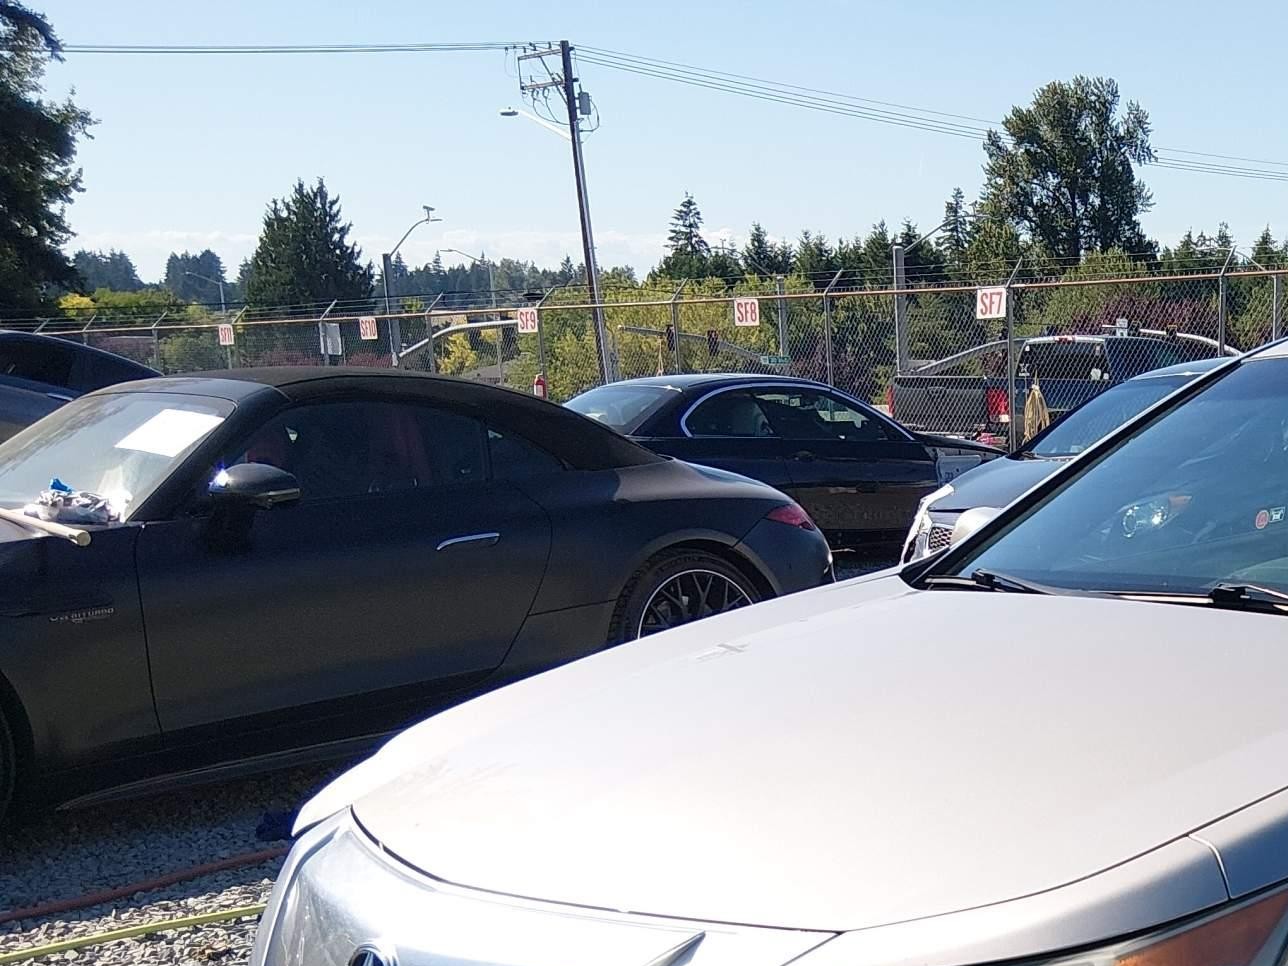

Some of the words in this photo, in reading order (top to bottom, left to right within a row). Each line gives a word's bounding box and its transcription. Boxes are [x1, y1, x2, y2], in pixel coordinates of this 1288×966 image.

[736, 301, 757, 322] SF8
[980, 291, 1003, 315] SF7
[360, 318, 377, 338] SF10
[519, 311, 536, 330] SF9
